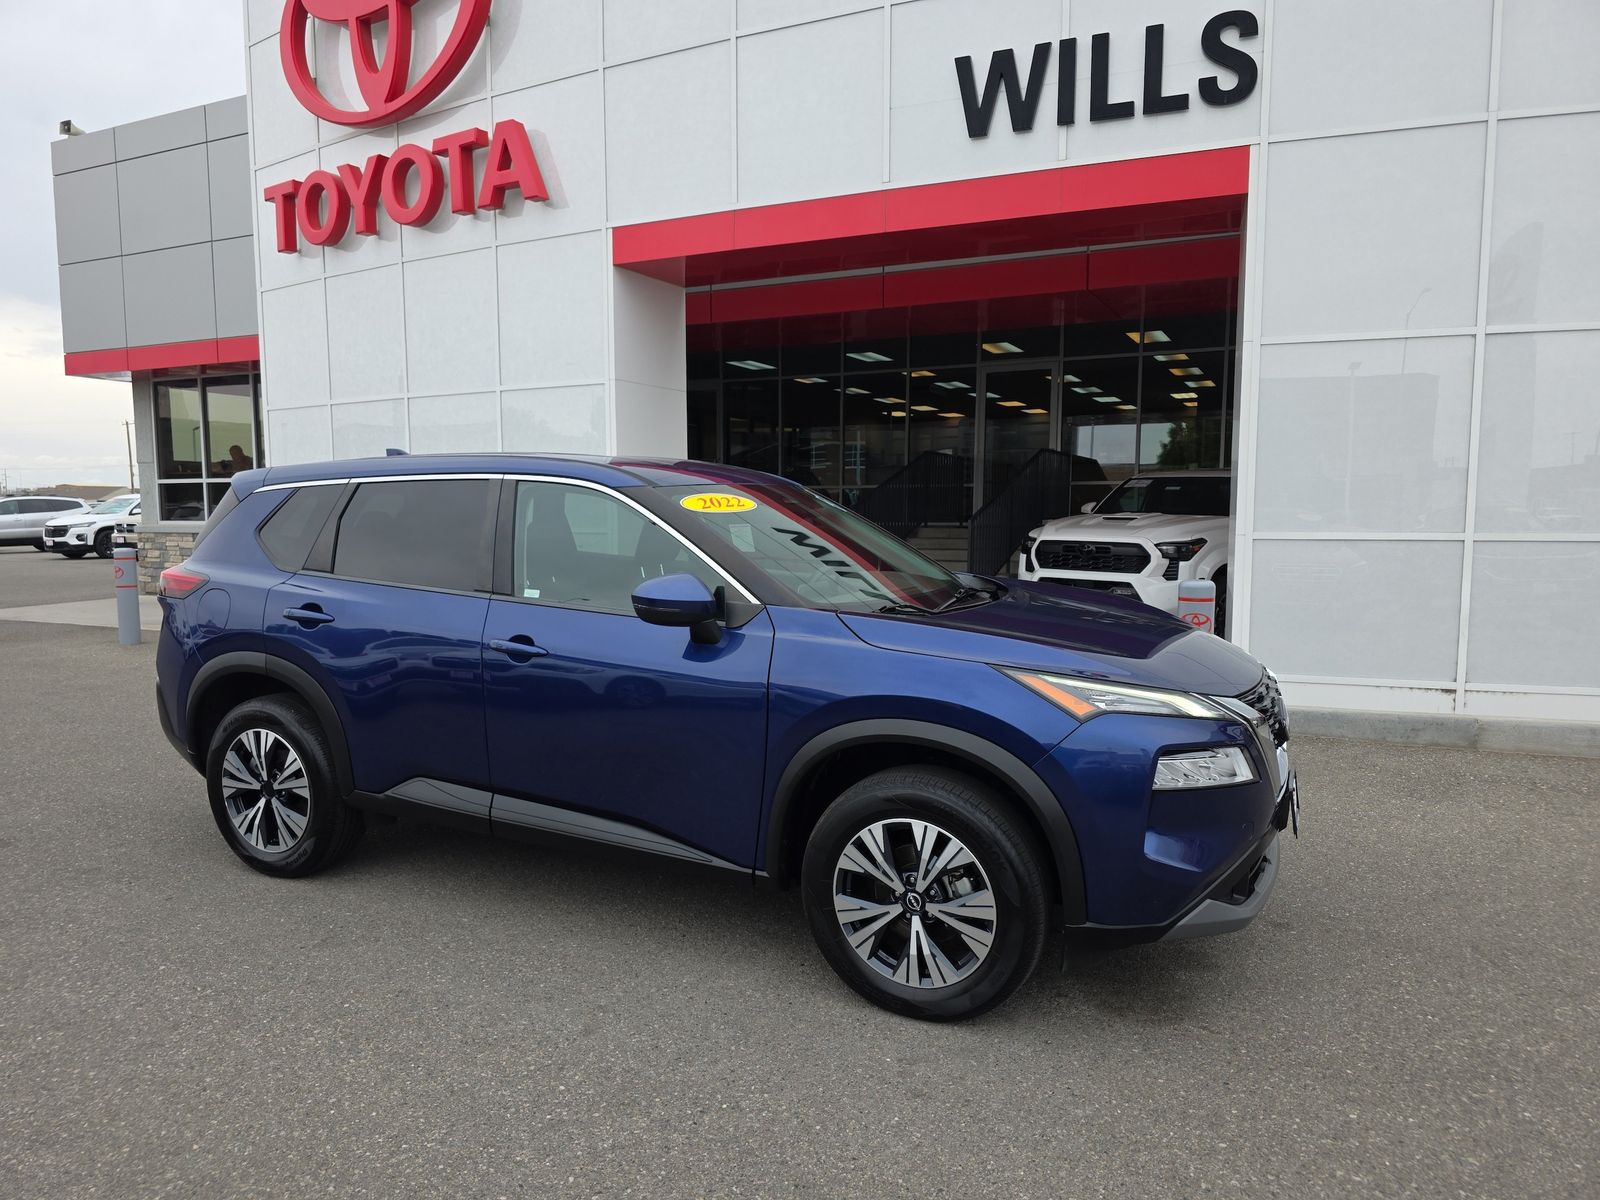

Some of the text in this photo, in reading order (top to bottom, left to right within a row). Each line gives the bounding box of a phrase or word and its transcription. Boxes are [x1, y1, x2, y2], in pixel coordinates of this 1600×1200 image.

[954, 9, 1259, 139] WILLS
[264, 118, 550, 254] TOYOTA
[696, 496, 745, 510] 2022
